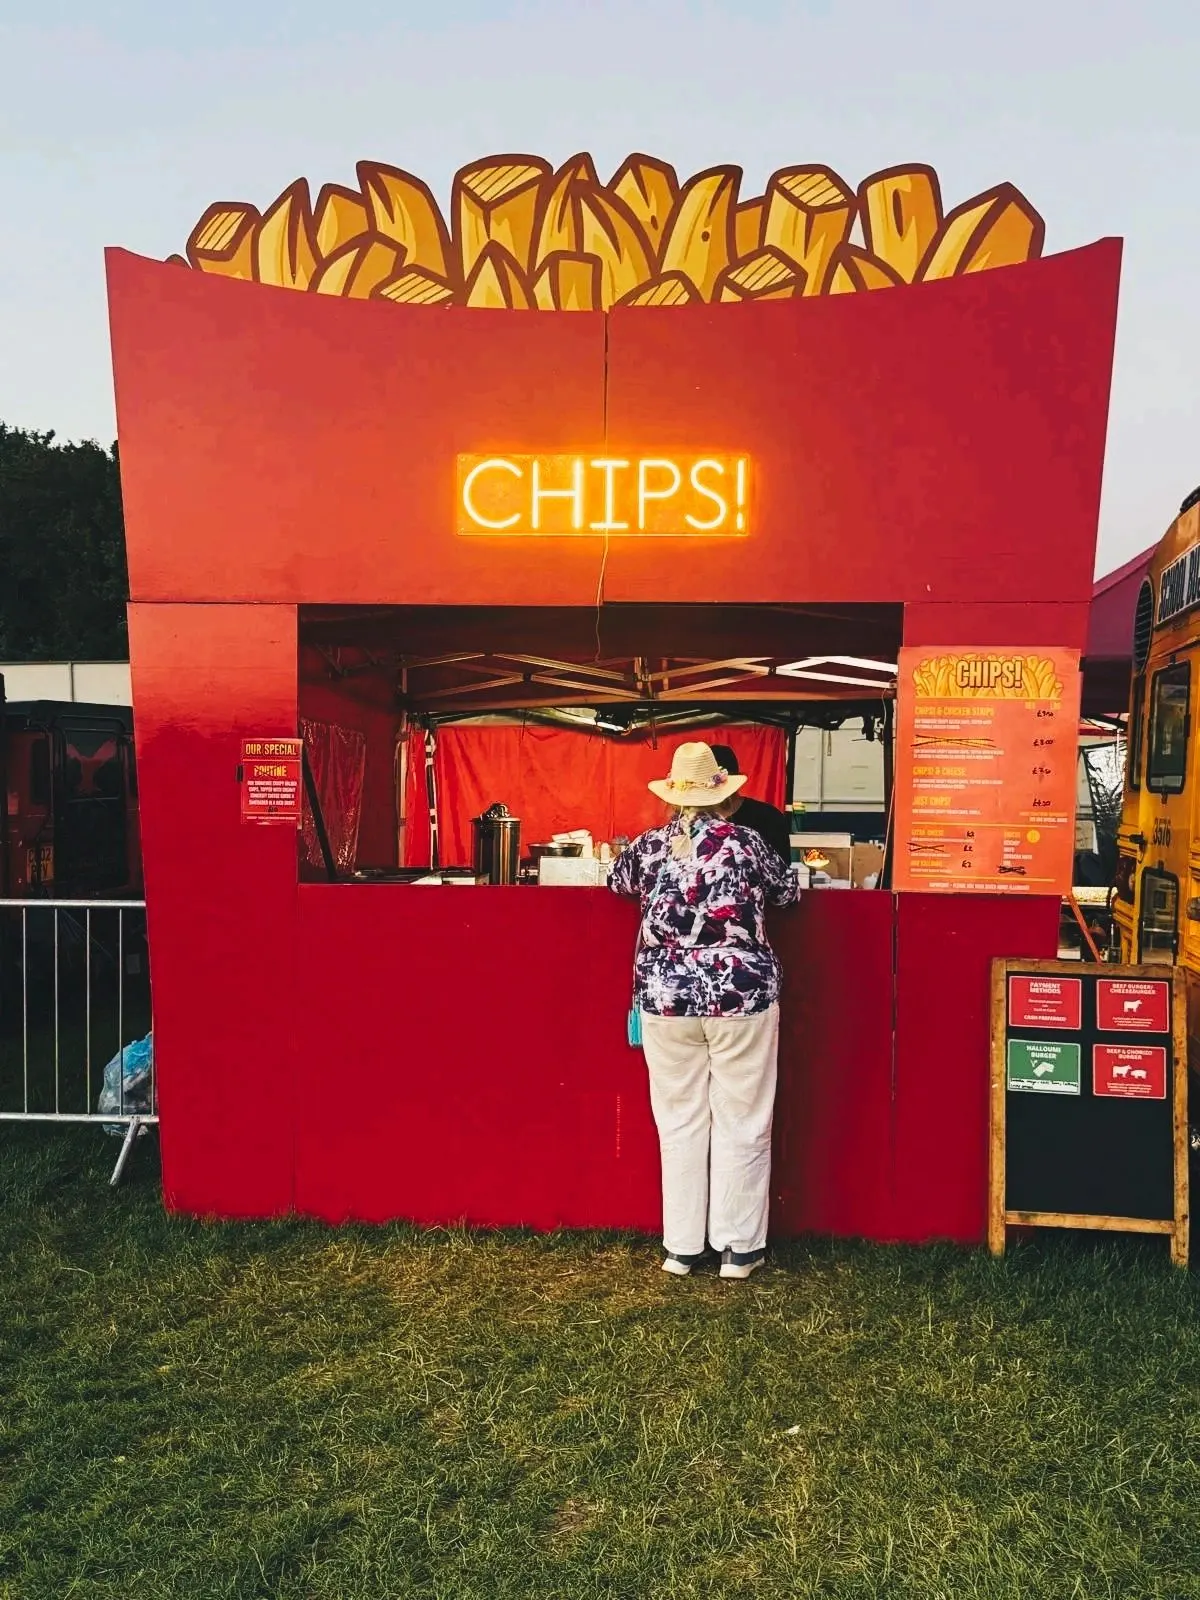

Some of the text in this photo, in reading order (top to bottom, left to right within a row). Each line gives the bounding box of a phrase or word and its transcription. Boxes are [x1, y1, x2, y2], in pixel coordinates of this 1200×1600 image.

[463, 458, 746, 530] CHIPS!
[1158, 556, 1186, 621] SCHOOL
[956, 659, 1023, 688] CHIPS!
[245, 743, 297, 755] OUR SPECIAL
[254, 765, 287, 777] POUTINE
[29, 847, 51, 863] C02
[1026, 1045, 1061, 1053] HALLOUMI
